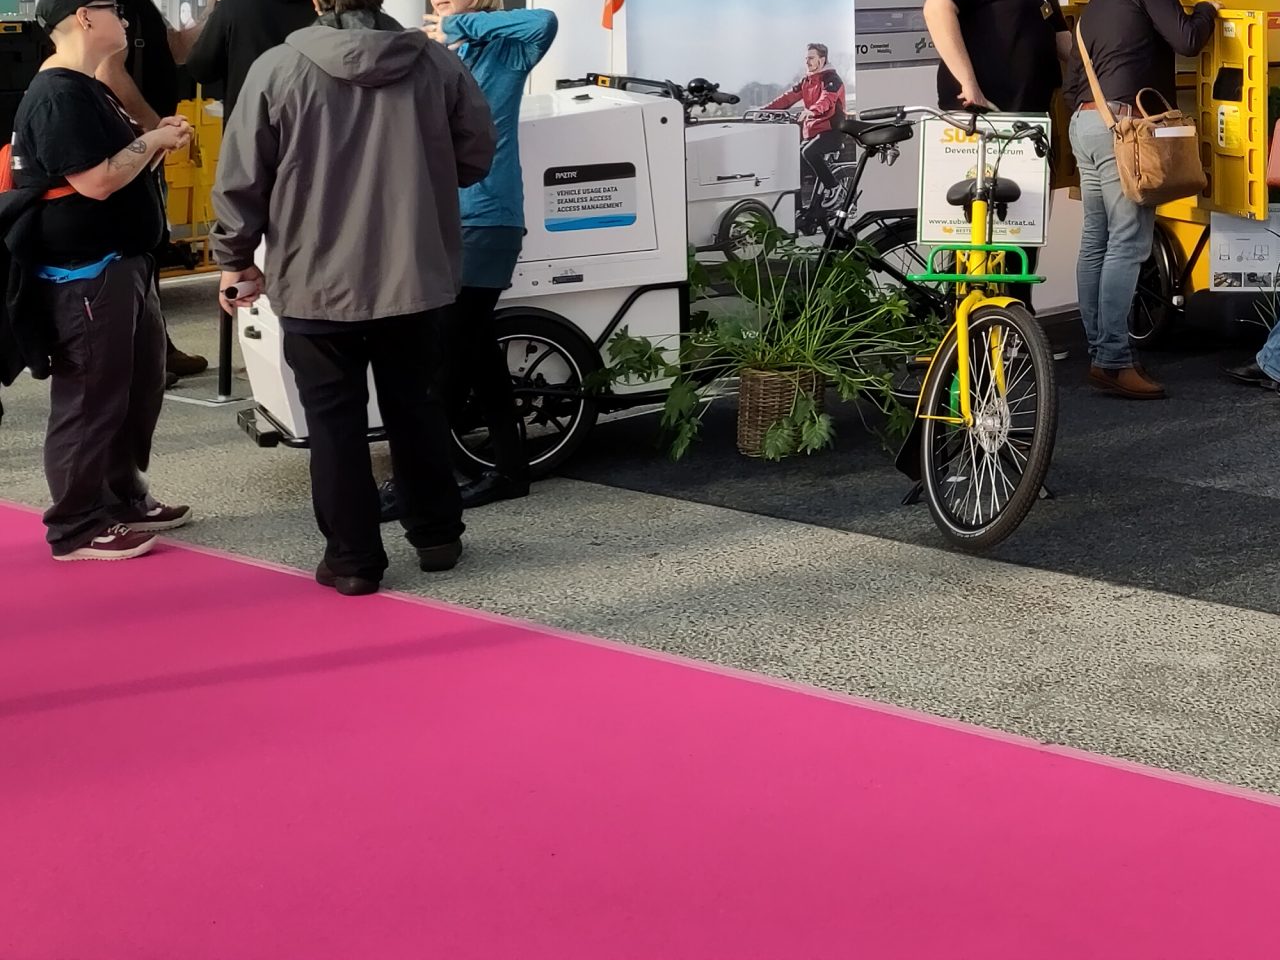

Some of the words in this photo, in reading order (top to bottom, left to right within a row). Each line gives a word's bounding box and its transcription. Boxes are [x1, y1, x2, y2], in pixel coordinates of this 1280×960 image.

[582, 187, 602, 195] USAGE
[557, 196, 588, 205] SEAMLESS
[557, 205, 580, 213] ACCESS
[581, 202, 623, 211] MANAGEMENT
